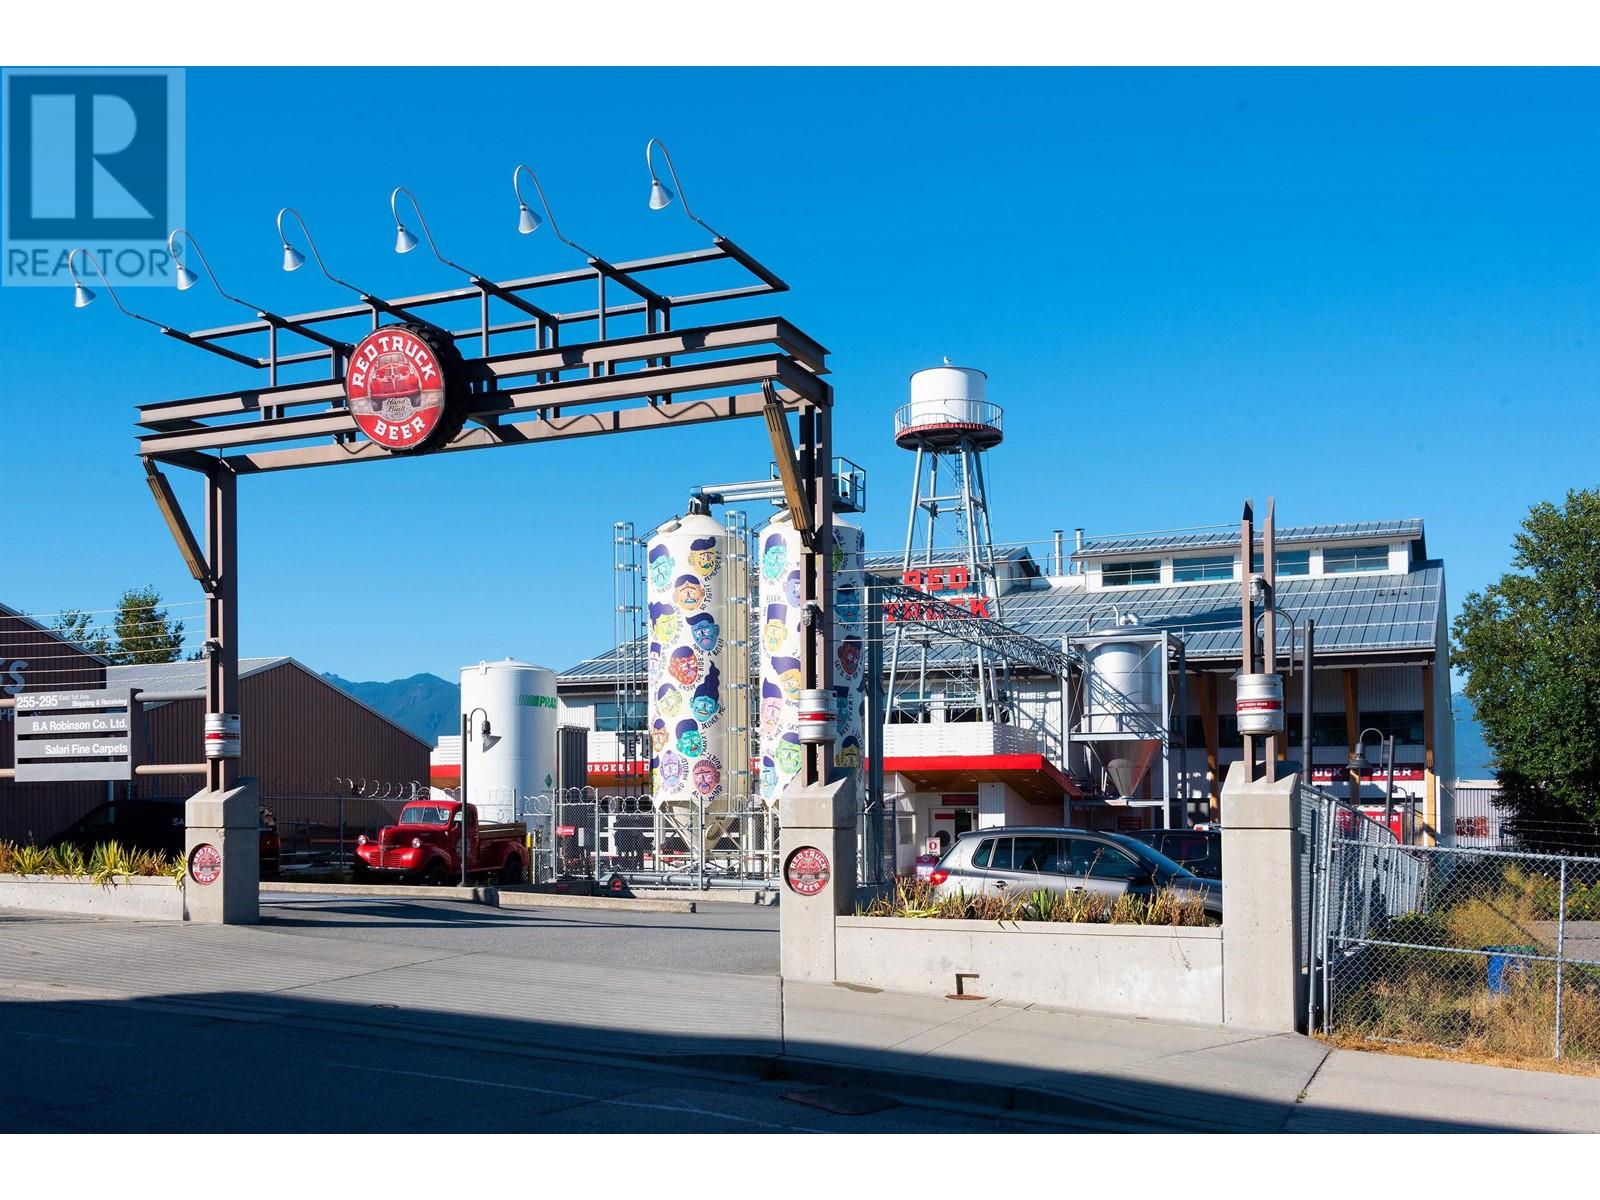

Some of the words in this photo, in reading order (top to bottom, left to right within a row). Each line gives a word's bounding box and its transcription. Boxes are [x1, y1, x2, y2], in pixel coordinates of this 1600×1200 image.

[352, 344, 378, 388] RED
[379, 336, 436, 381] TRUCK
[374, 416, 425, 440] BEER
[17, 695, 58, 708] 255-295
[72, 700, 95, 708] Shipping
[101, 698, 128, 706] Receiving
[33, 721, 48, 731] B.A
[50, 720, 91, 731] Robinson
[93, 719, 108, 729] Co.
[110, 718, 128, 729] Ltd.
[45, 744, 70, 755] Salari
[72, 744, 90, 754] Fine
[92, 743, 128, 756] Carpets
[790, 852, 804, 869] RED
[804, 850, 828, 870] TRUCK
[797, 882, 820, 891] BEER
